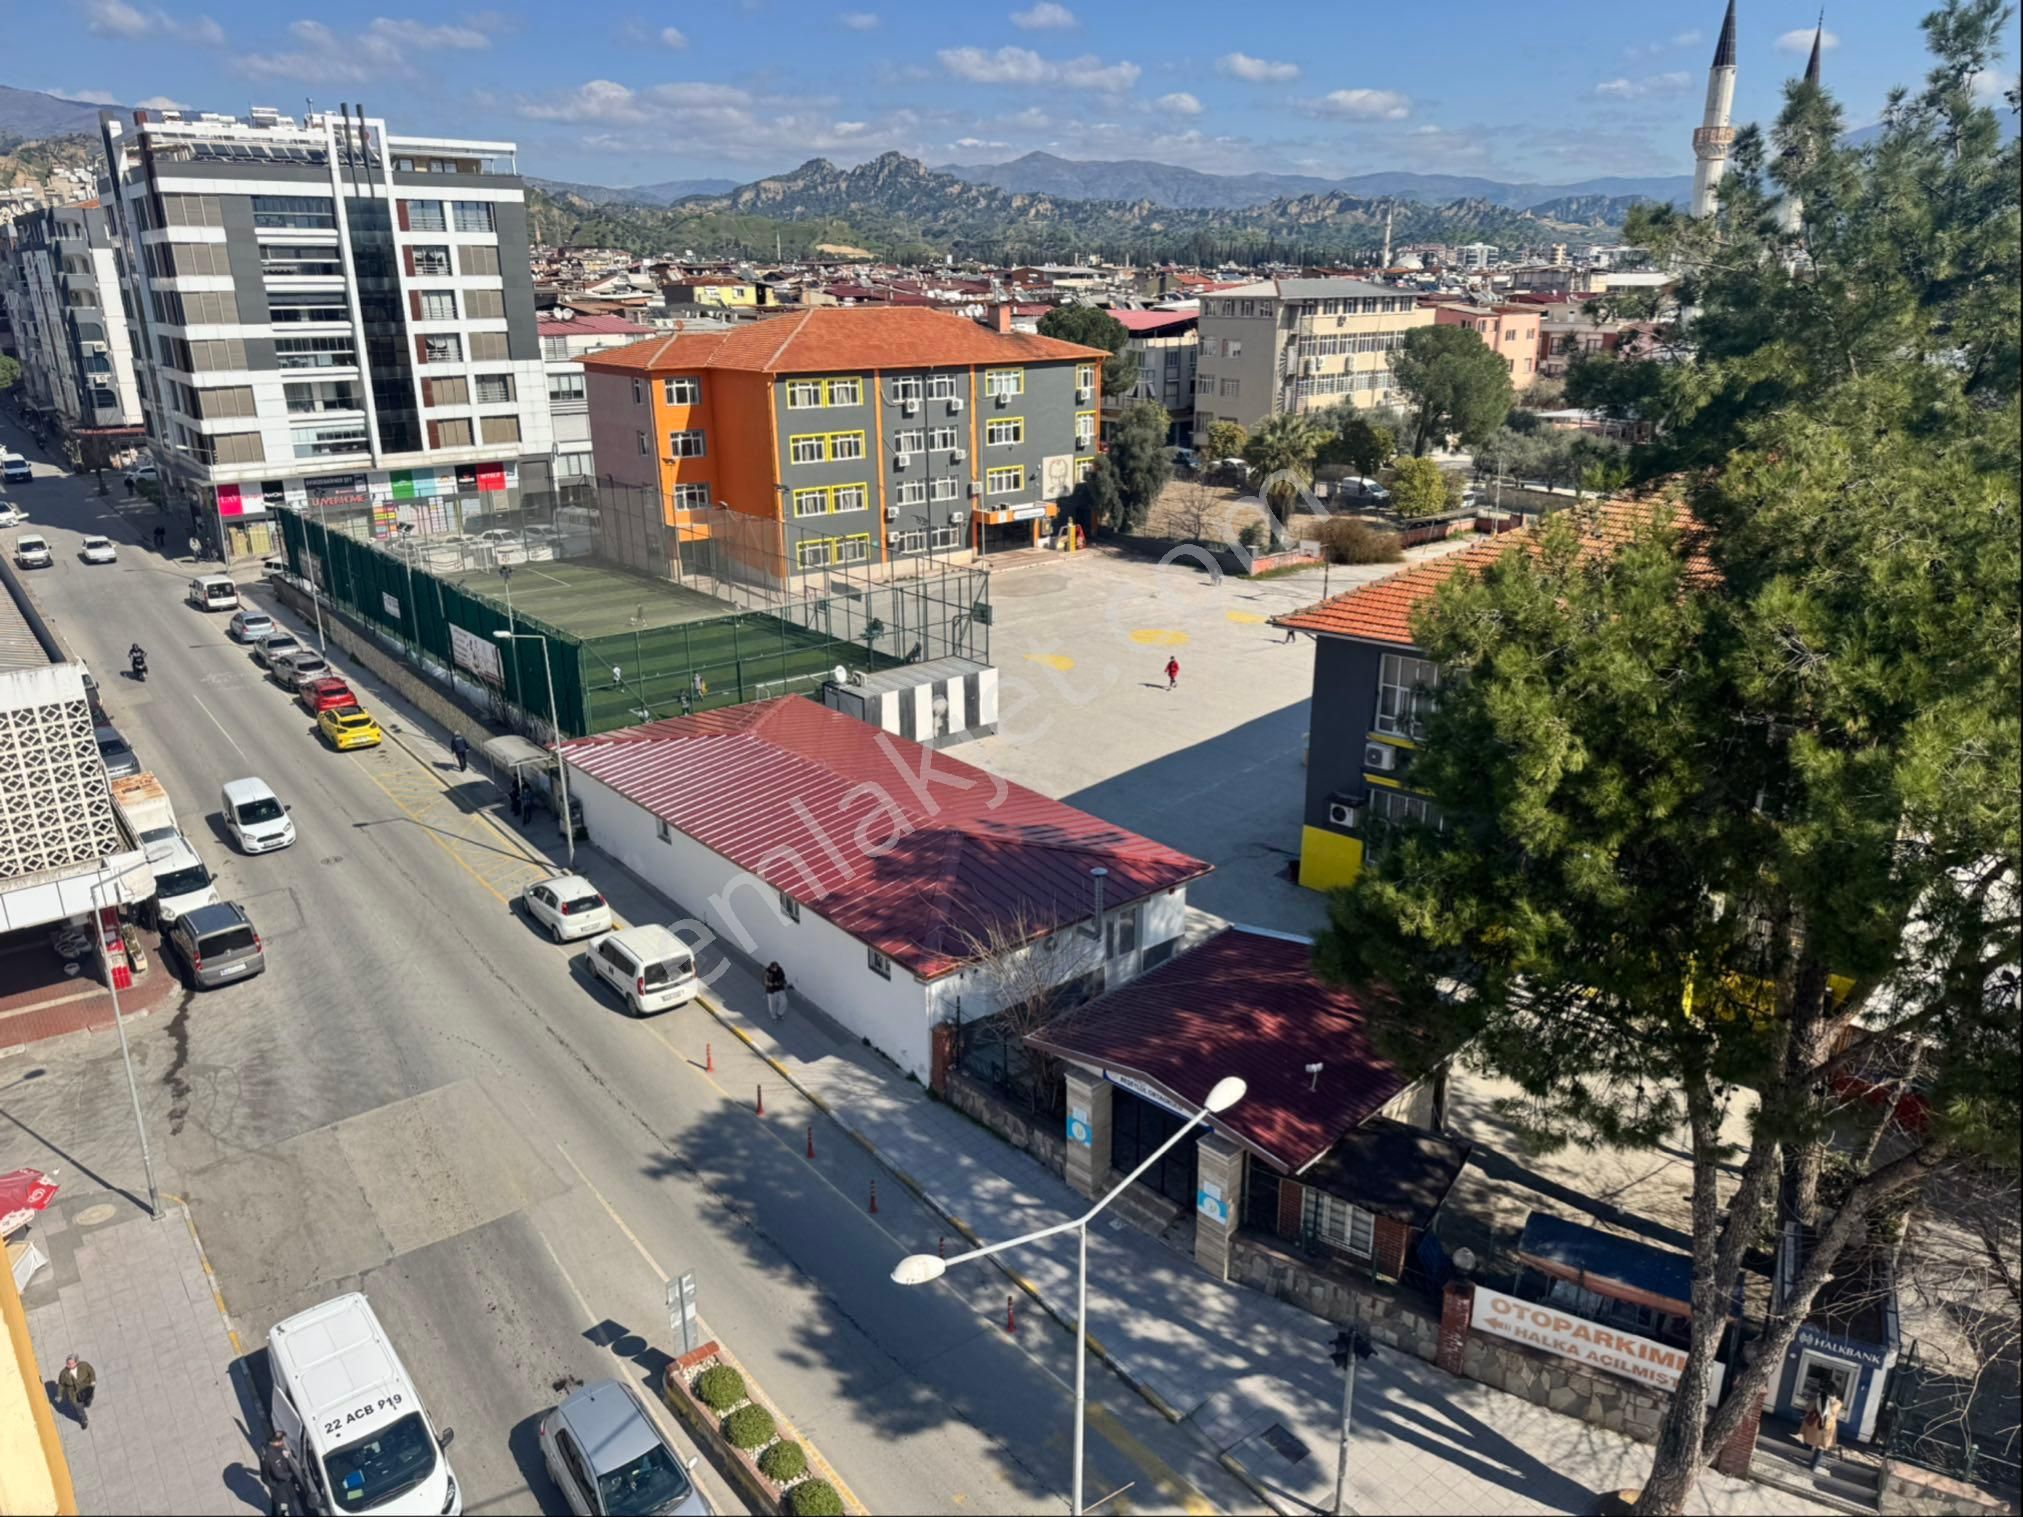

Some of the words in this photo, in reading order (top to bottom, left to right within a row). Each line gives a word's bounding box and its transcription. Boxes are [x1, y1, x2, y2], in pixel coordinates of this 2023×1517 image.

[1491, 1297, 1686, 1372] OTOPARKIMI
[1514, 1325, 1579, 1356] HALKA
[1586, 1350, 1680, 1388] AÇILMIŞT
[1814, 1338, 1881, 1364] HALKBANK
[324, 1418, 343, 1434] 22
[346, 1404, 374, 1424] ACB
